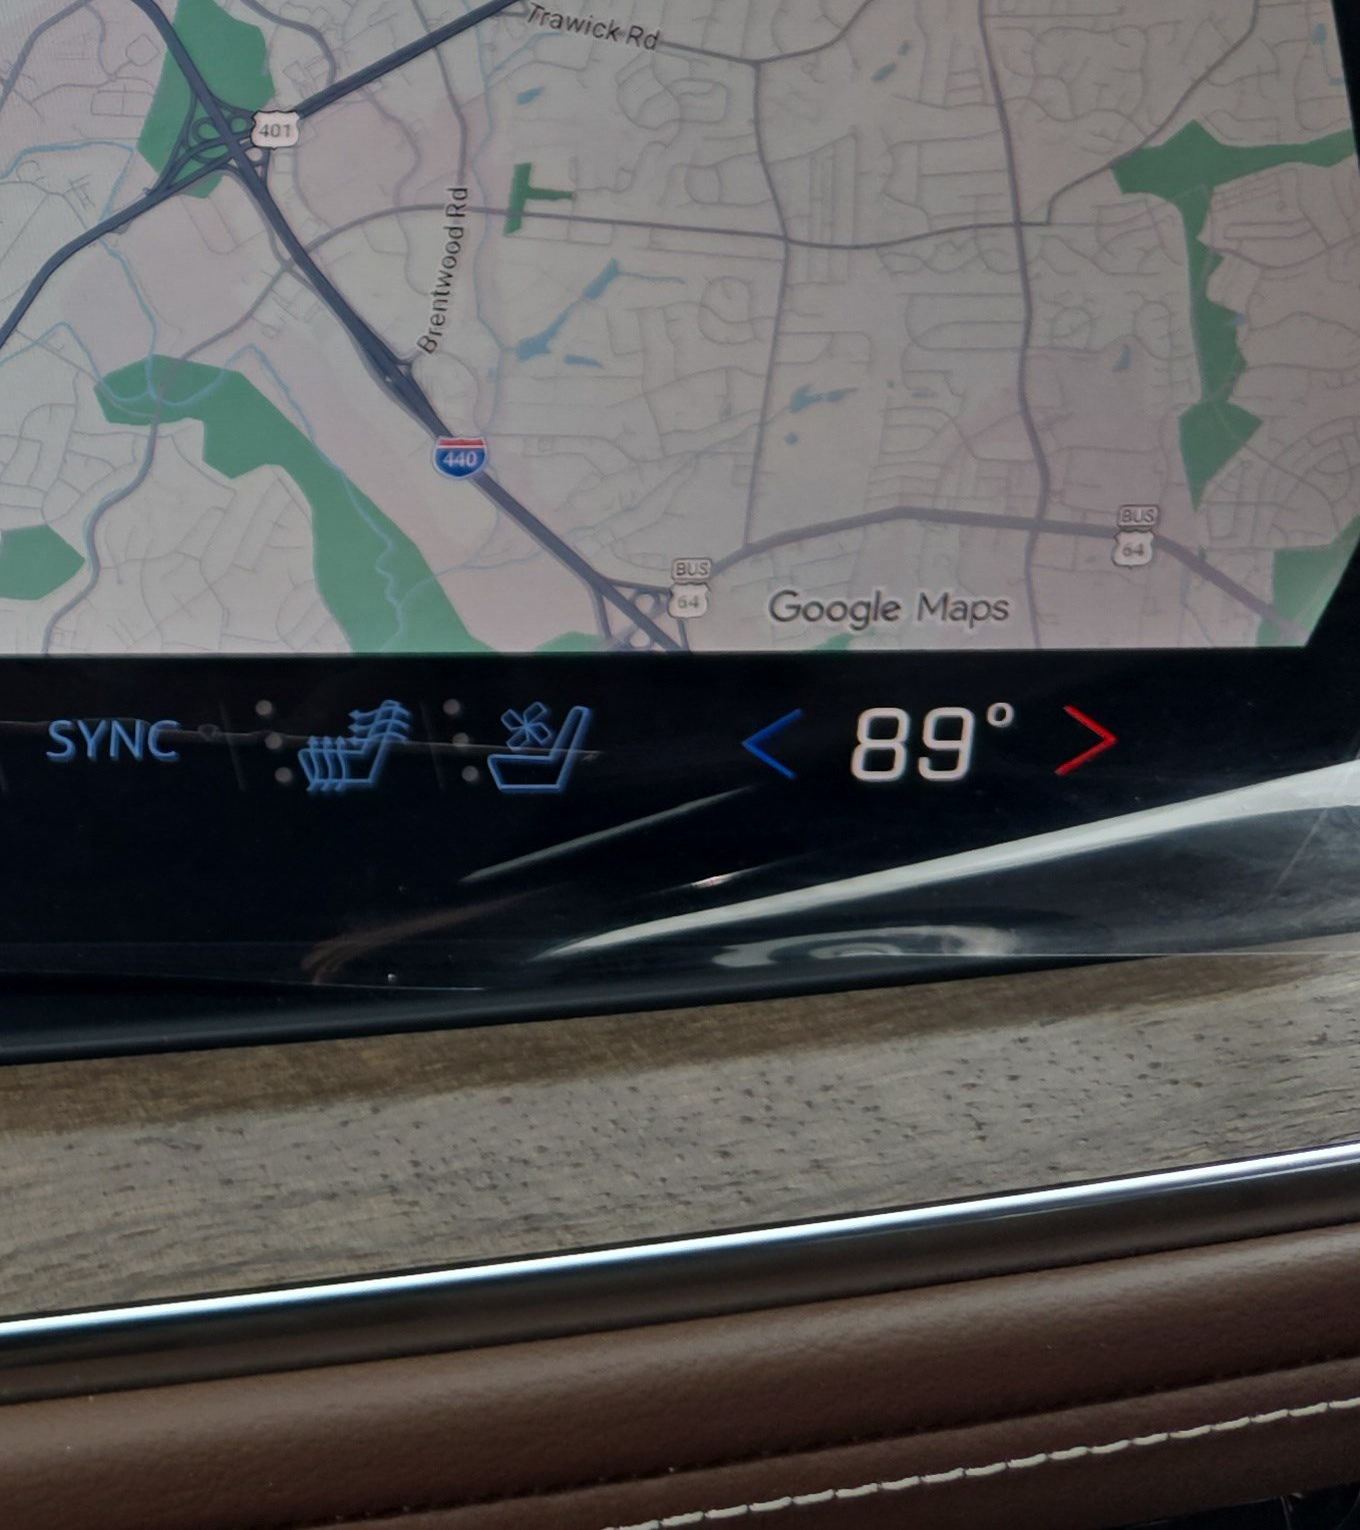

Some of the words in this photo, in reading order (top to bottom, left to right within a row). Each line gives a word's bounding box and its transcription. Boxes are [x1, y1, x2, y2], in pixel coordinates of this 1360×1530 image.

[526, 3, 619, 41] Trawick
[625, 26, 659, 51] Rd
[259, 122, 291, 139] 401
[418, 226, 464, 355] Brentwood
[448, 187, 468, 218] Rd
[442, 451, 478, 468] 440
[1120, 508, 1154, 524] BUS
[675, 562, 709, 578] BUS
[768, 589, 901, 631] Google
[918, 591, 1010, 629] Maps
[46, 719, 180, 762] SYNC
[851, 701, 1014, 782] 89°
